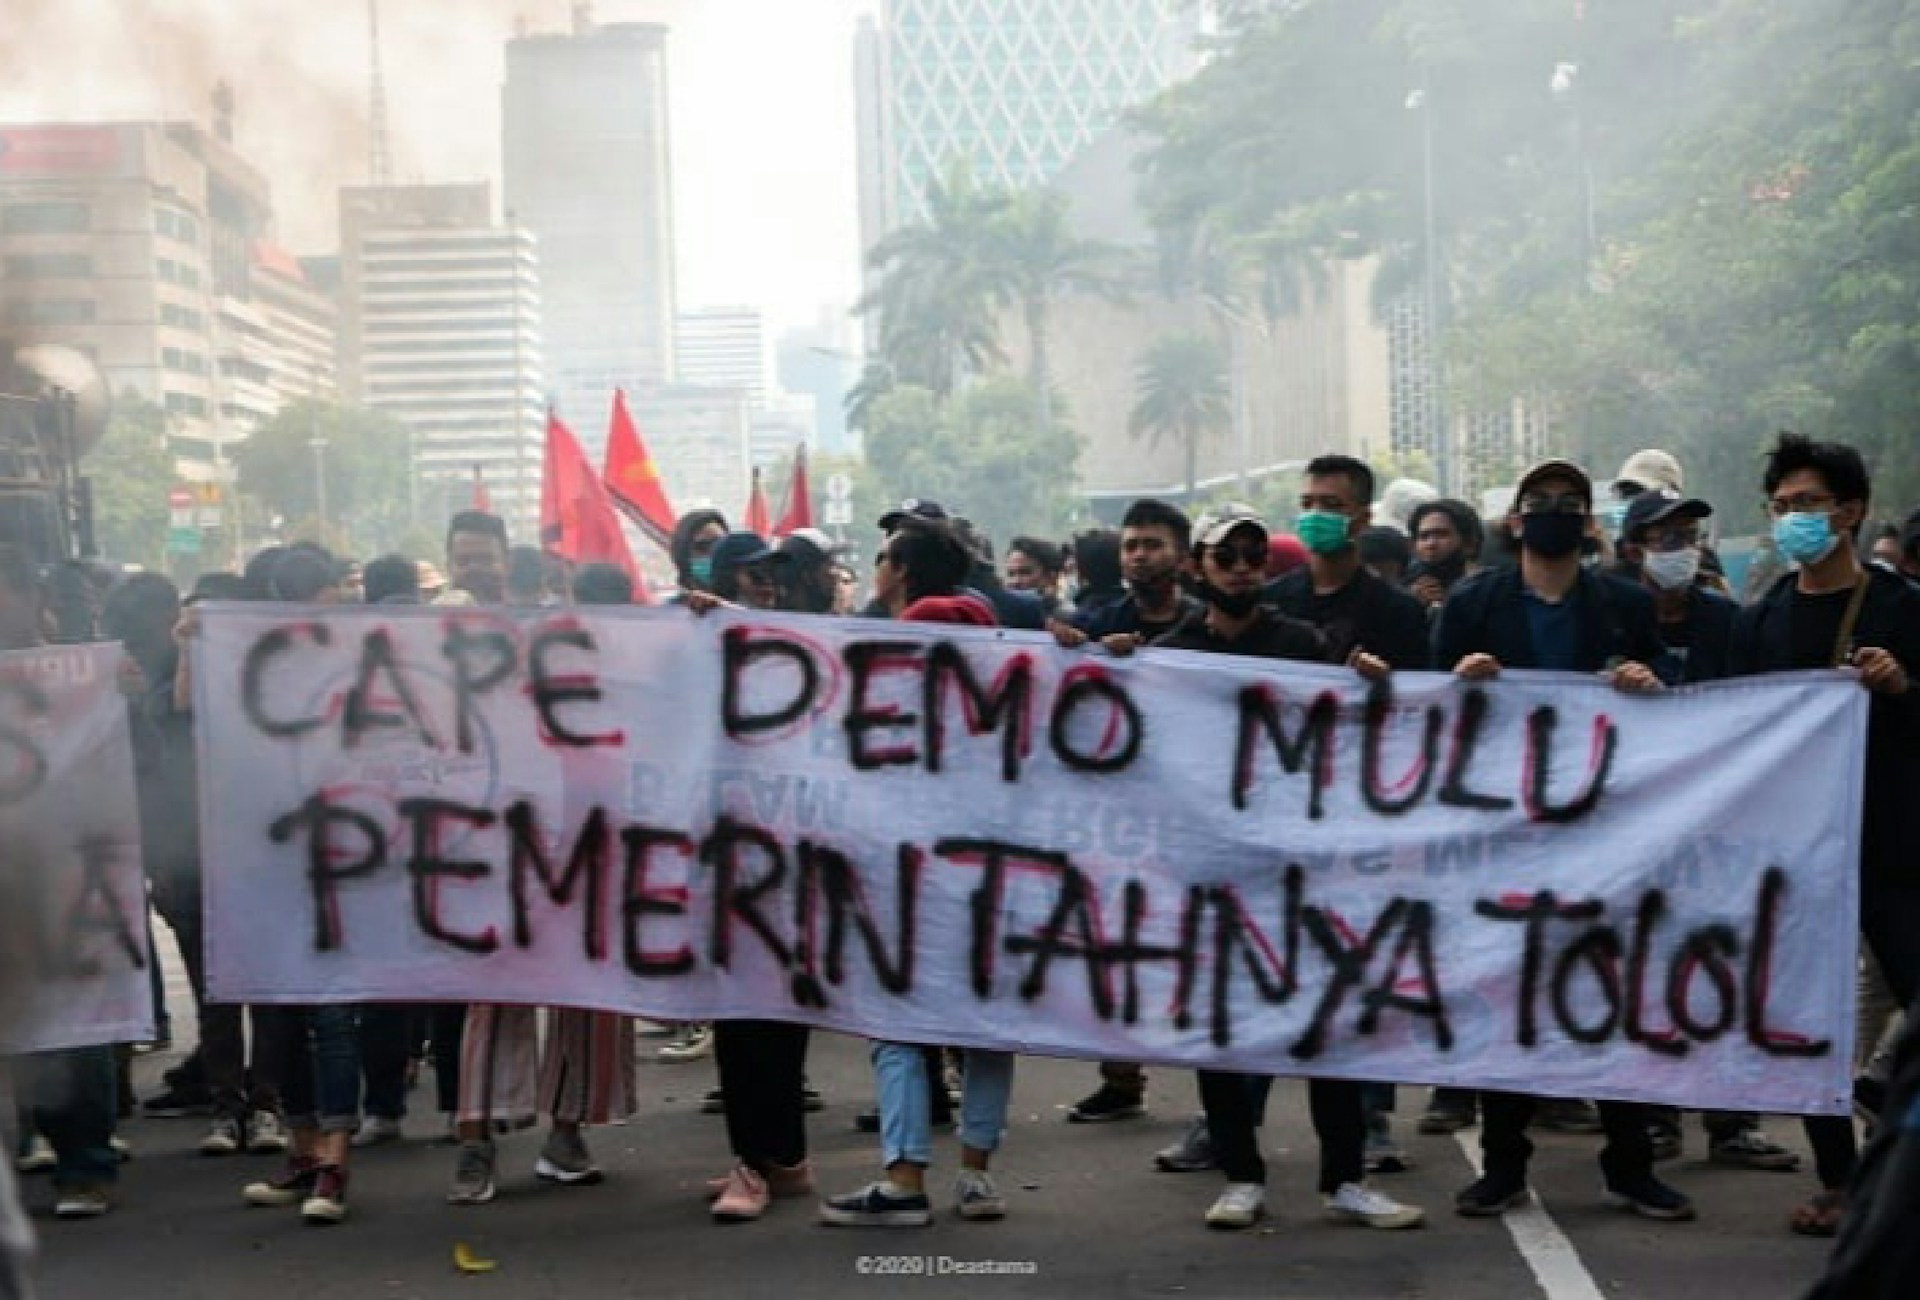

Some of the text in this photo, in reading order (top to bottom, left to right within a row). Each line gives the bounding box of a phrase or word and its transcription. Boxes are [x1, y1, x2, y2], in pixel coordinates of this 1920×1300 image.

[240, 611, 1618, 822] CAPE DEMO MULU
[268, 790, 1452, 1060] PEMERINTAHNYA
